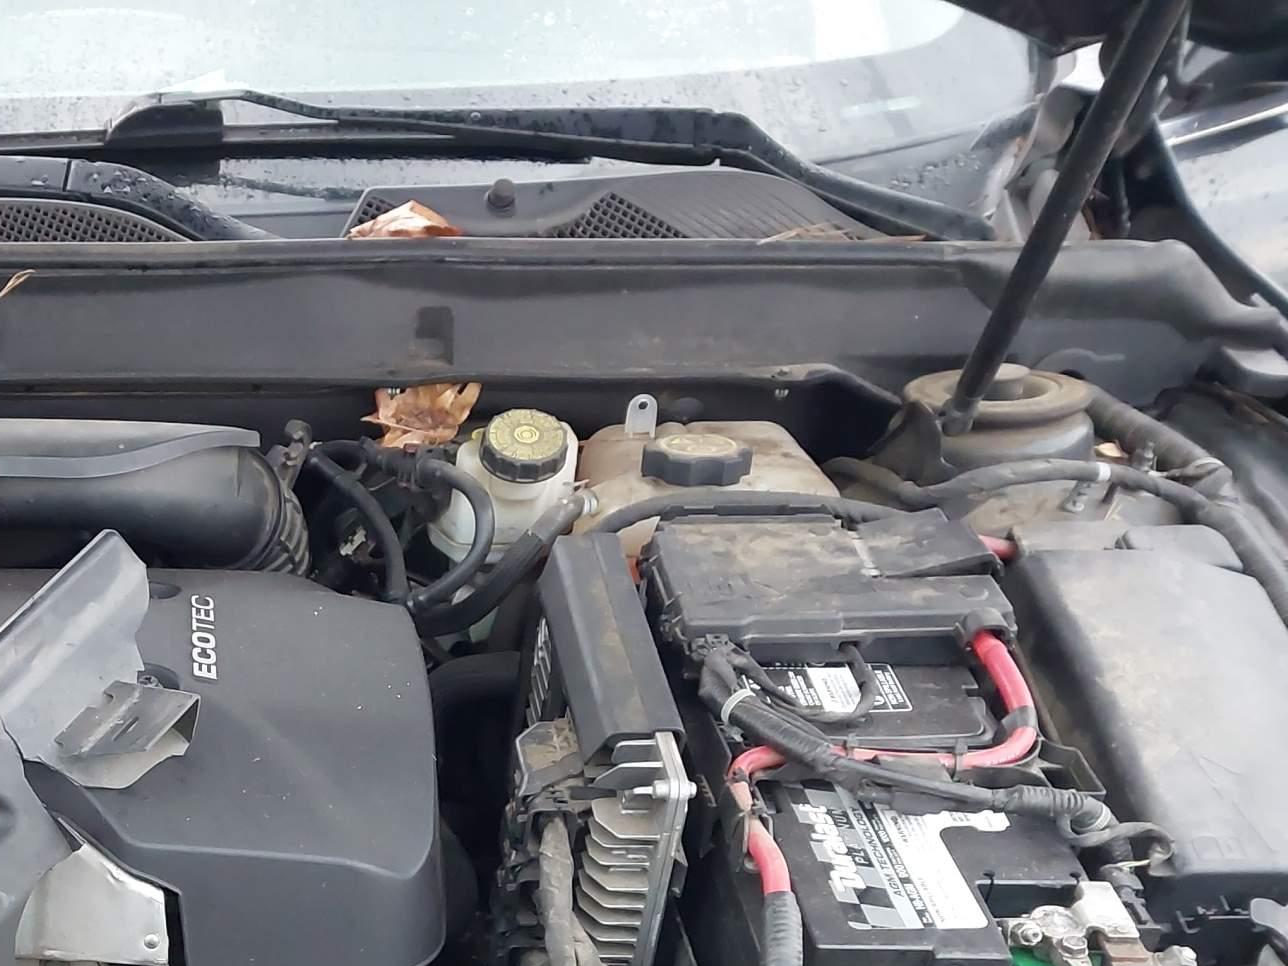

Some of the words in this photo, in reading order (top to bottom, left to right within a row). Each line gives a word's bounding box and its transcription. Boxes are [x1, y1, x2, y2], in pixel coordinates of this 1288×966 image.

[191, 595, 217, 680] ECOTEC
[799, 803, 867, 892] Duralast
[831, 809, 871, 865] PLANU
[850, 806, 889, 871] TECHNOLOGY
[884, 874, 904, 898] AGM
